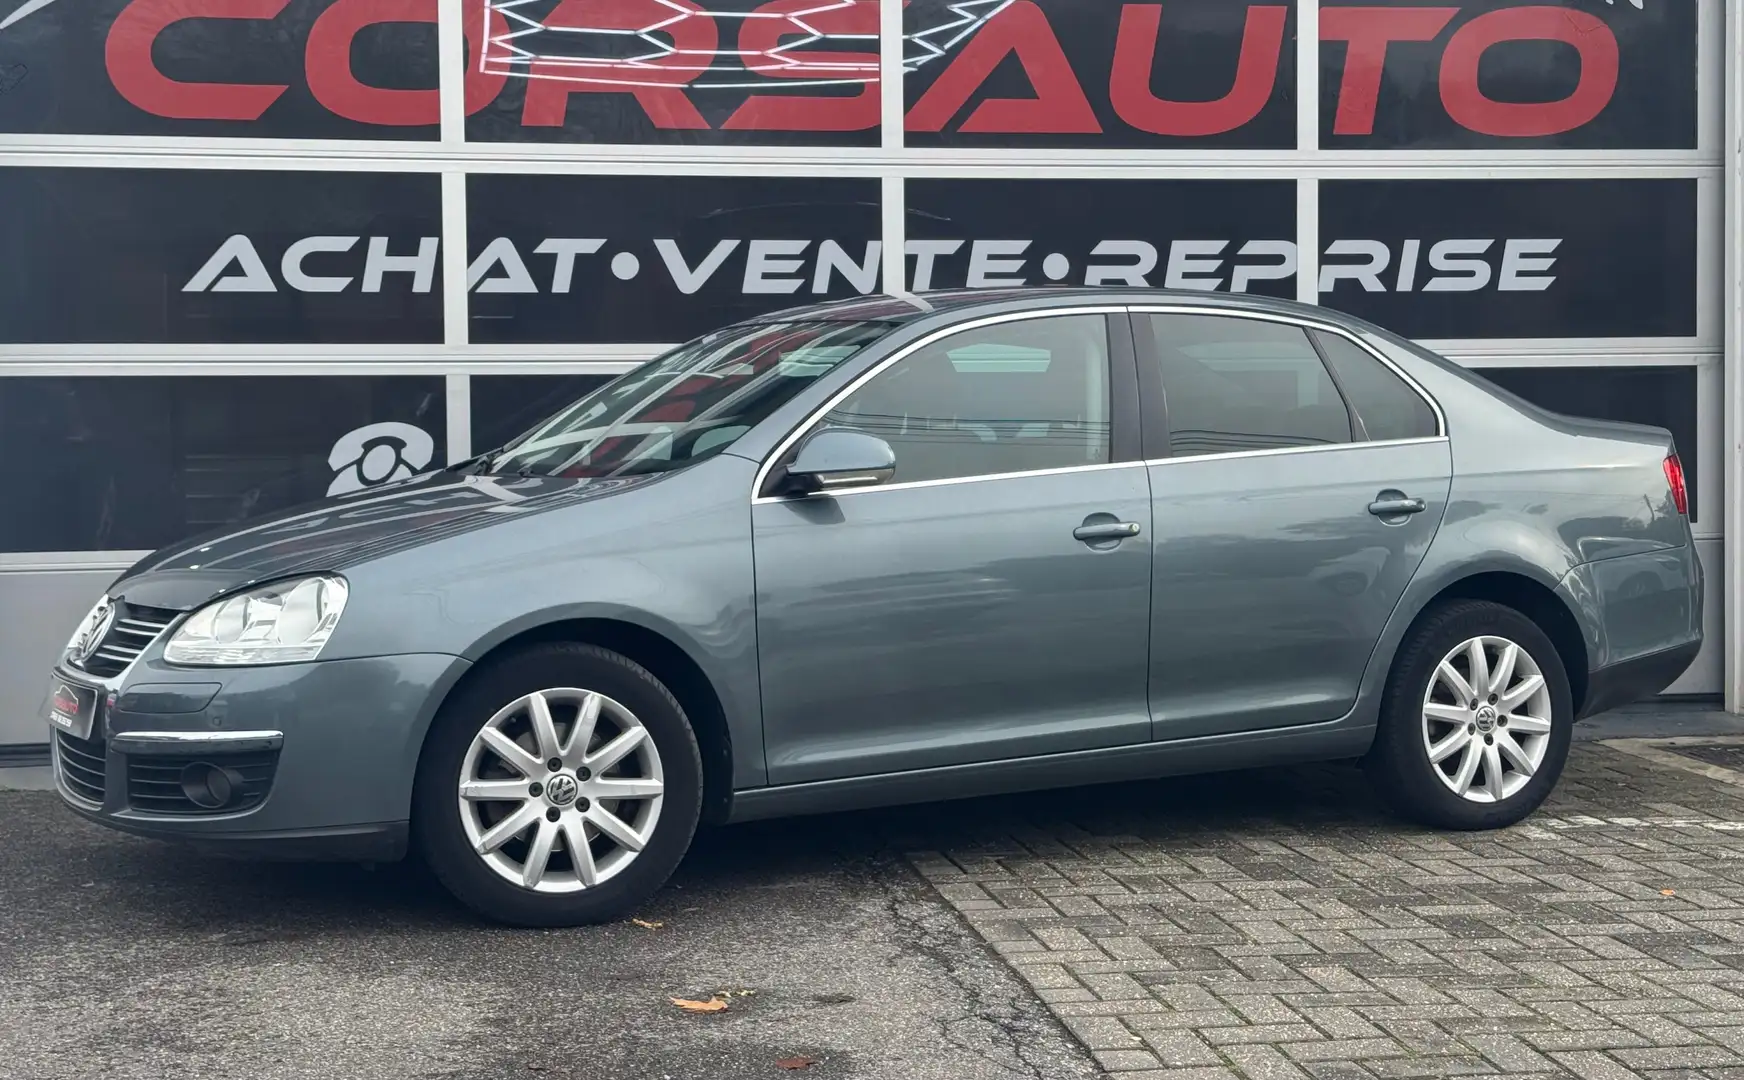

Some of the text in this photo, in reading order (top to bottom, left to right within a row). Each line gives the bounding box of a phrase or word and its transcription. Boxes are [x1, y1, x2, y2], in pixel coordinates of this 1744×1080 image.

[105, 0, 1619, 136] CORSAUTO
[182, 234, 1562, 295] ACHAT VENTE REPRISE
